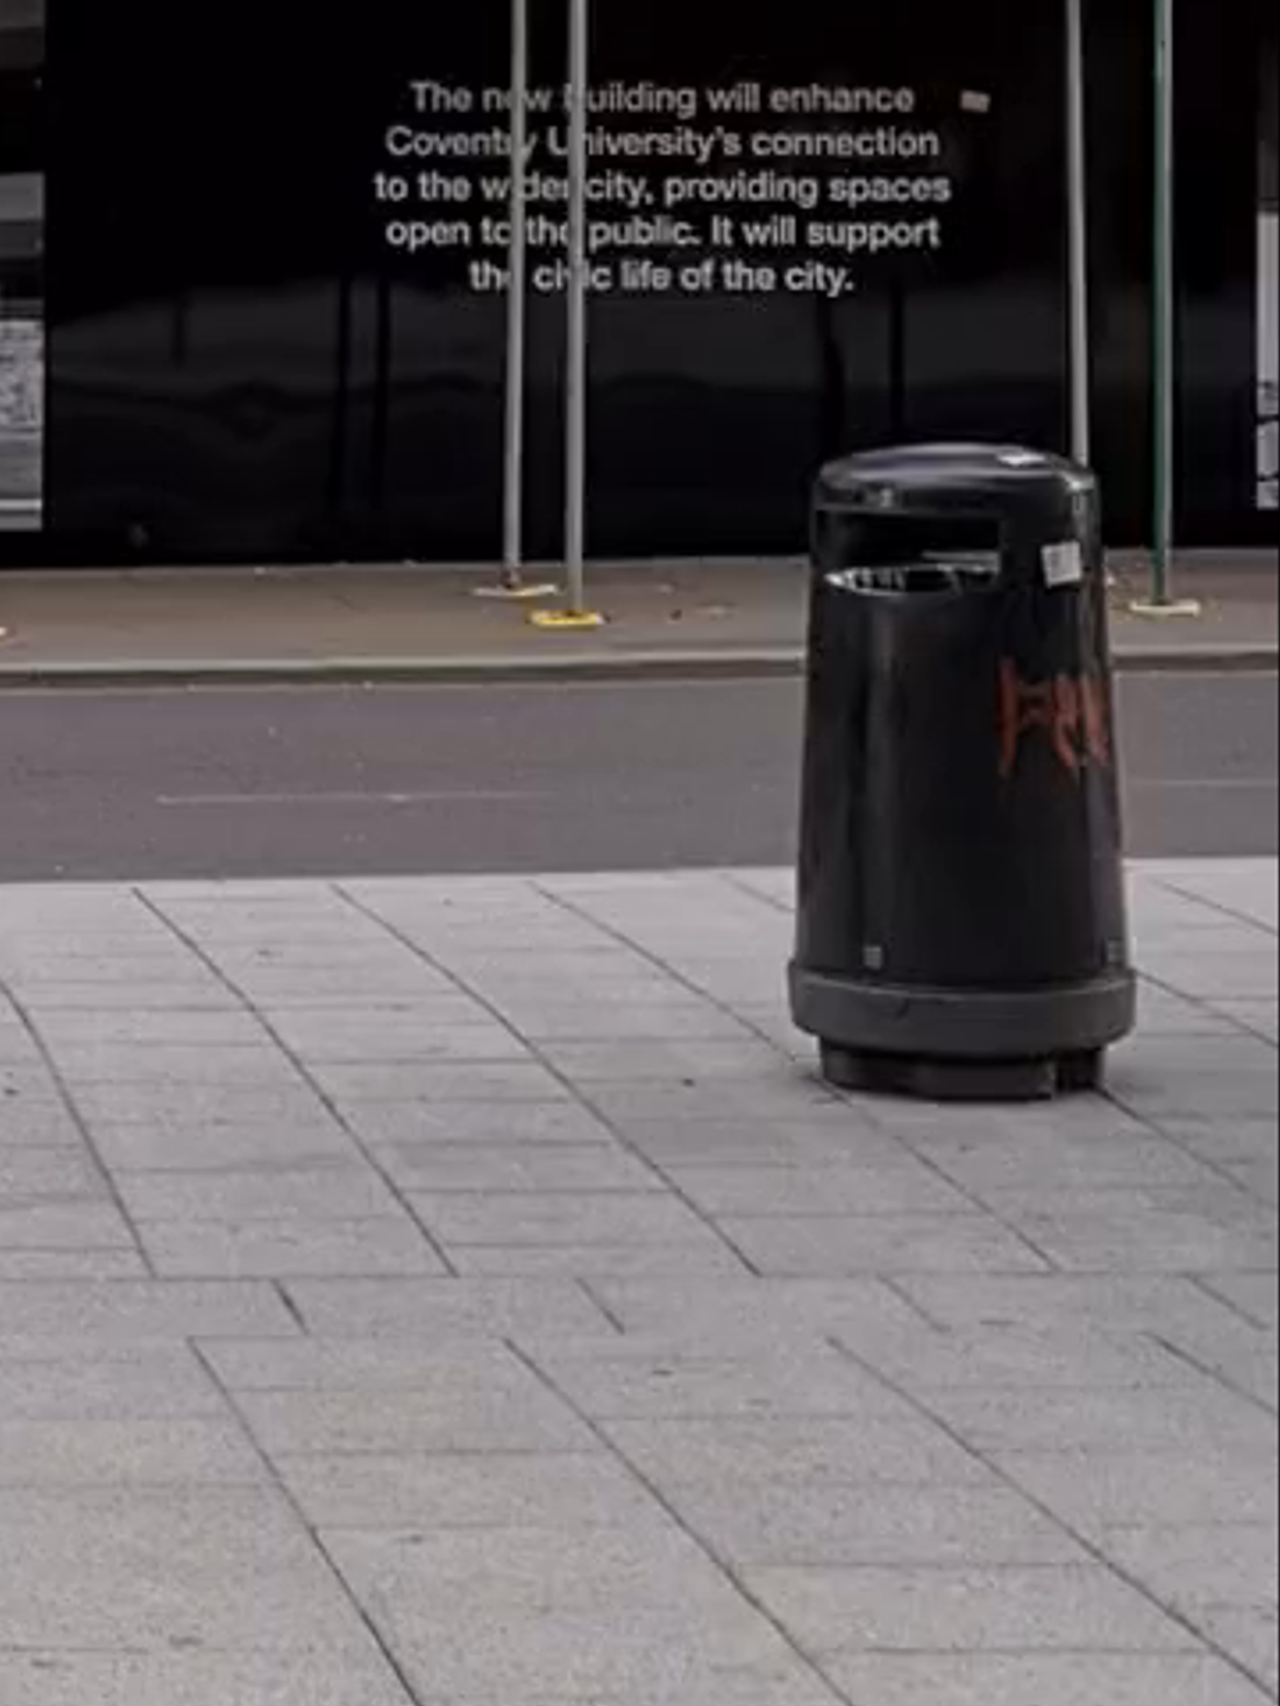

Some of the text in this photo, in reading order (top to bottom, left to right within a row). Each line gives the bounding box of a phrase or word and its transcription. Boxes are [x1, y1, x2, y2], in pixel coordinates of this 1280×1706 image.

[410, 81, 473, 114] The
[706, 82, 762, 114] will
[769, 83, 916, 114] enhance
[751, 125, 940, 157] connection
[373, 168, 953, 209] to the wder city, providing spaces
[385, 220, 471, 253] open
[589, 215, 702, 254] public.
[711, 215, 734, 247] It
[741, 215, 797, 247] will
[806, 217, 942, 254] support
[619, 258, 673, 291] life
[679, 258, 715, 291] of
[722, 258, 776, 291] the
[785, 259, 855, 299] city.
